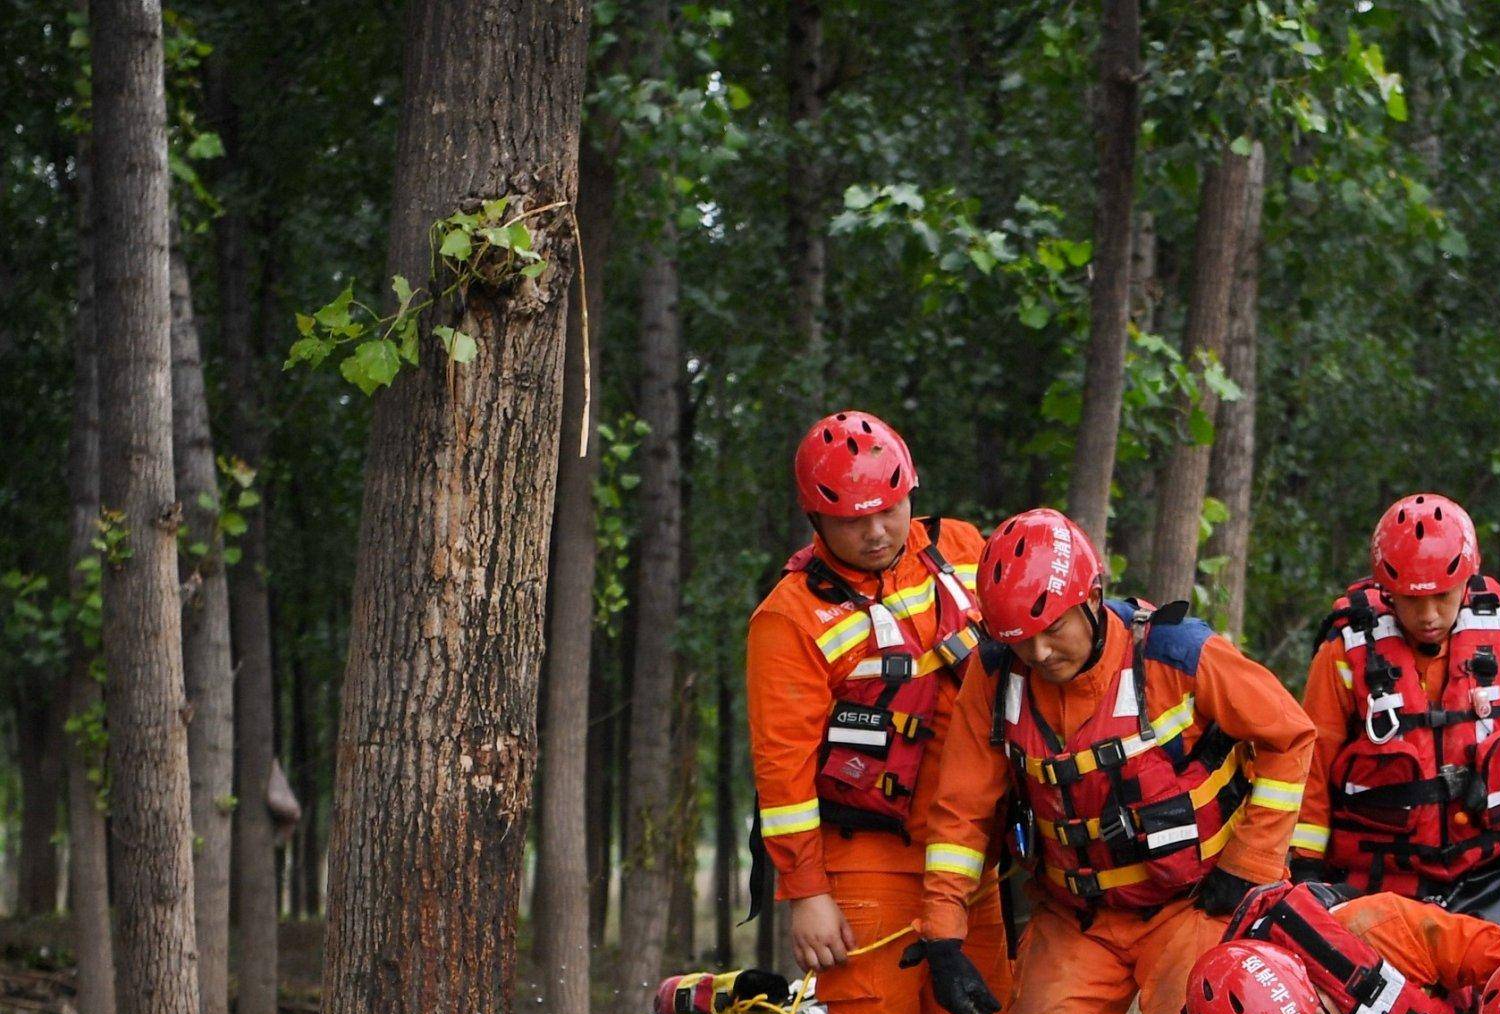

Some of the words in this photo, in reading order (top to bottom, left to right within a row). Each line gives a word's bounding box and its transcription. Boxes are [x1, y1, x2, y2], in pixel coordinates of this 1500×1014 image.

[1047, 526, 1073, 597] 河北消防
[1410, 582, 1437, 591] NRS
